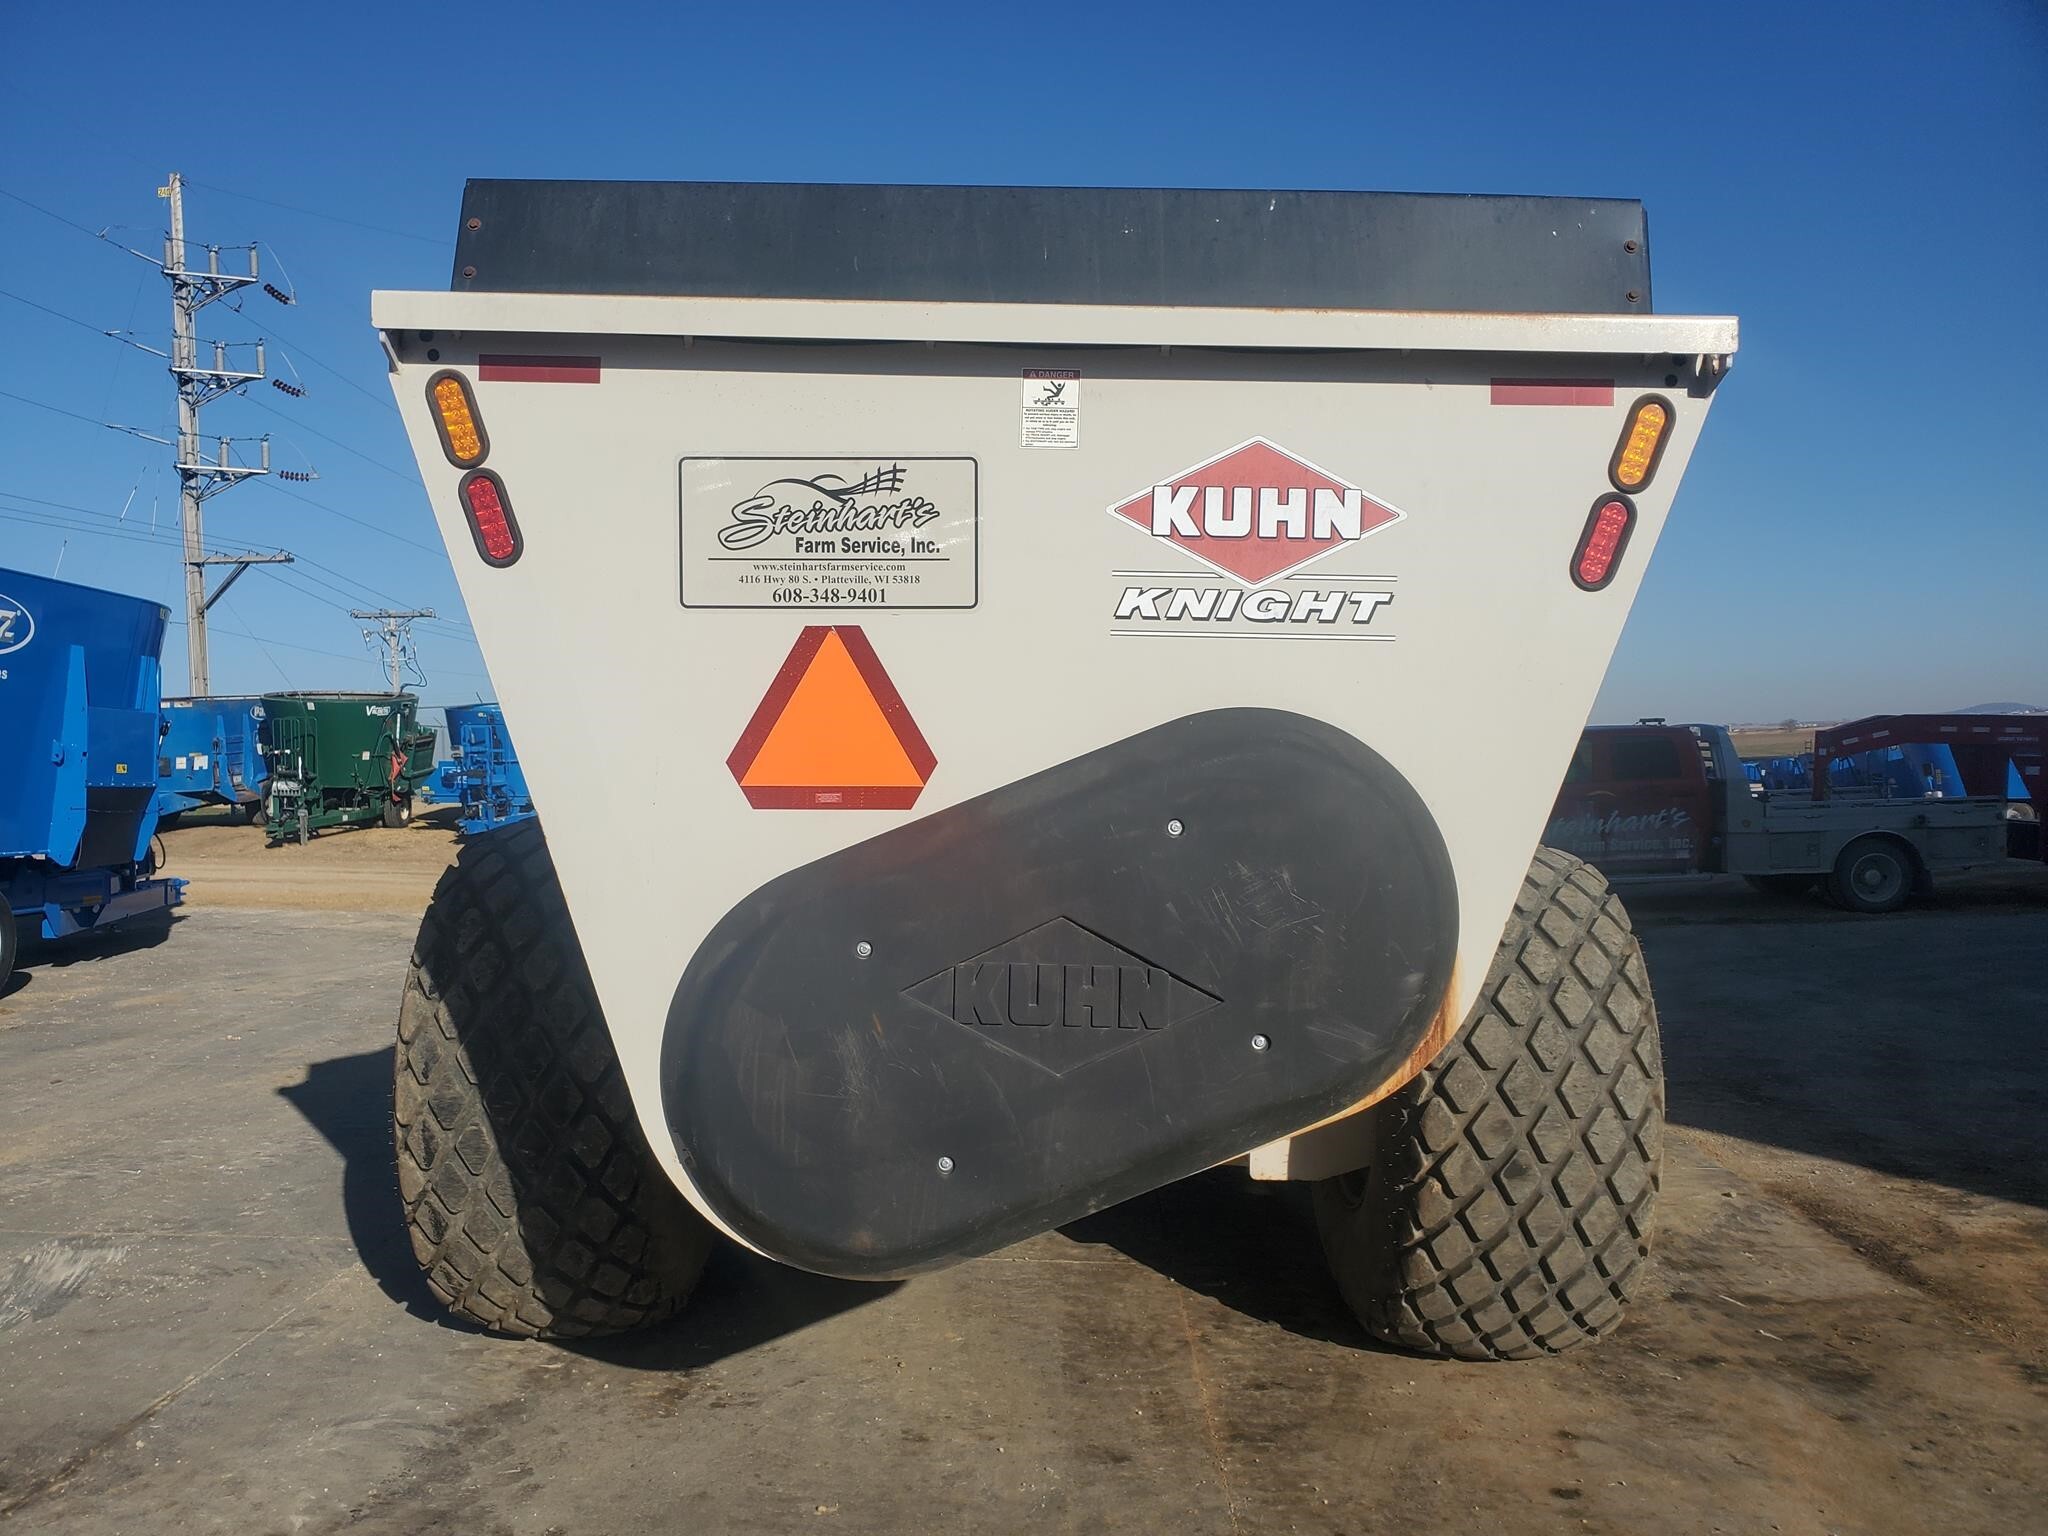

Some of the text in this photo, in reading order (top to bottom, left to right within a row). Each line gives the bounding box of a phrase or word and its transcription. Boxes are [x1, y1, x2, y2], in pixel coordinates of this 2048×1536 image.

[1151, 485, 1362, 540] KUHN
[718, 495, 940, 550] Steinhart's
[795, 537, 940, 556] Farm Service, Inc.
[753, 562, 906, 571] www.steinhartsfarmservice.com
[738, 574, 921, 586] 4116 Hwy 80 S. Platteville, WI 53818
[772, 588, 887, 603] 608-348-9401
[1113, 587, 1395, 624] KNIGHT
[1669, 837, 1694, 849] Inc.
[952, 961, 1170, 1030] KUHN
